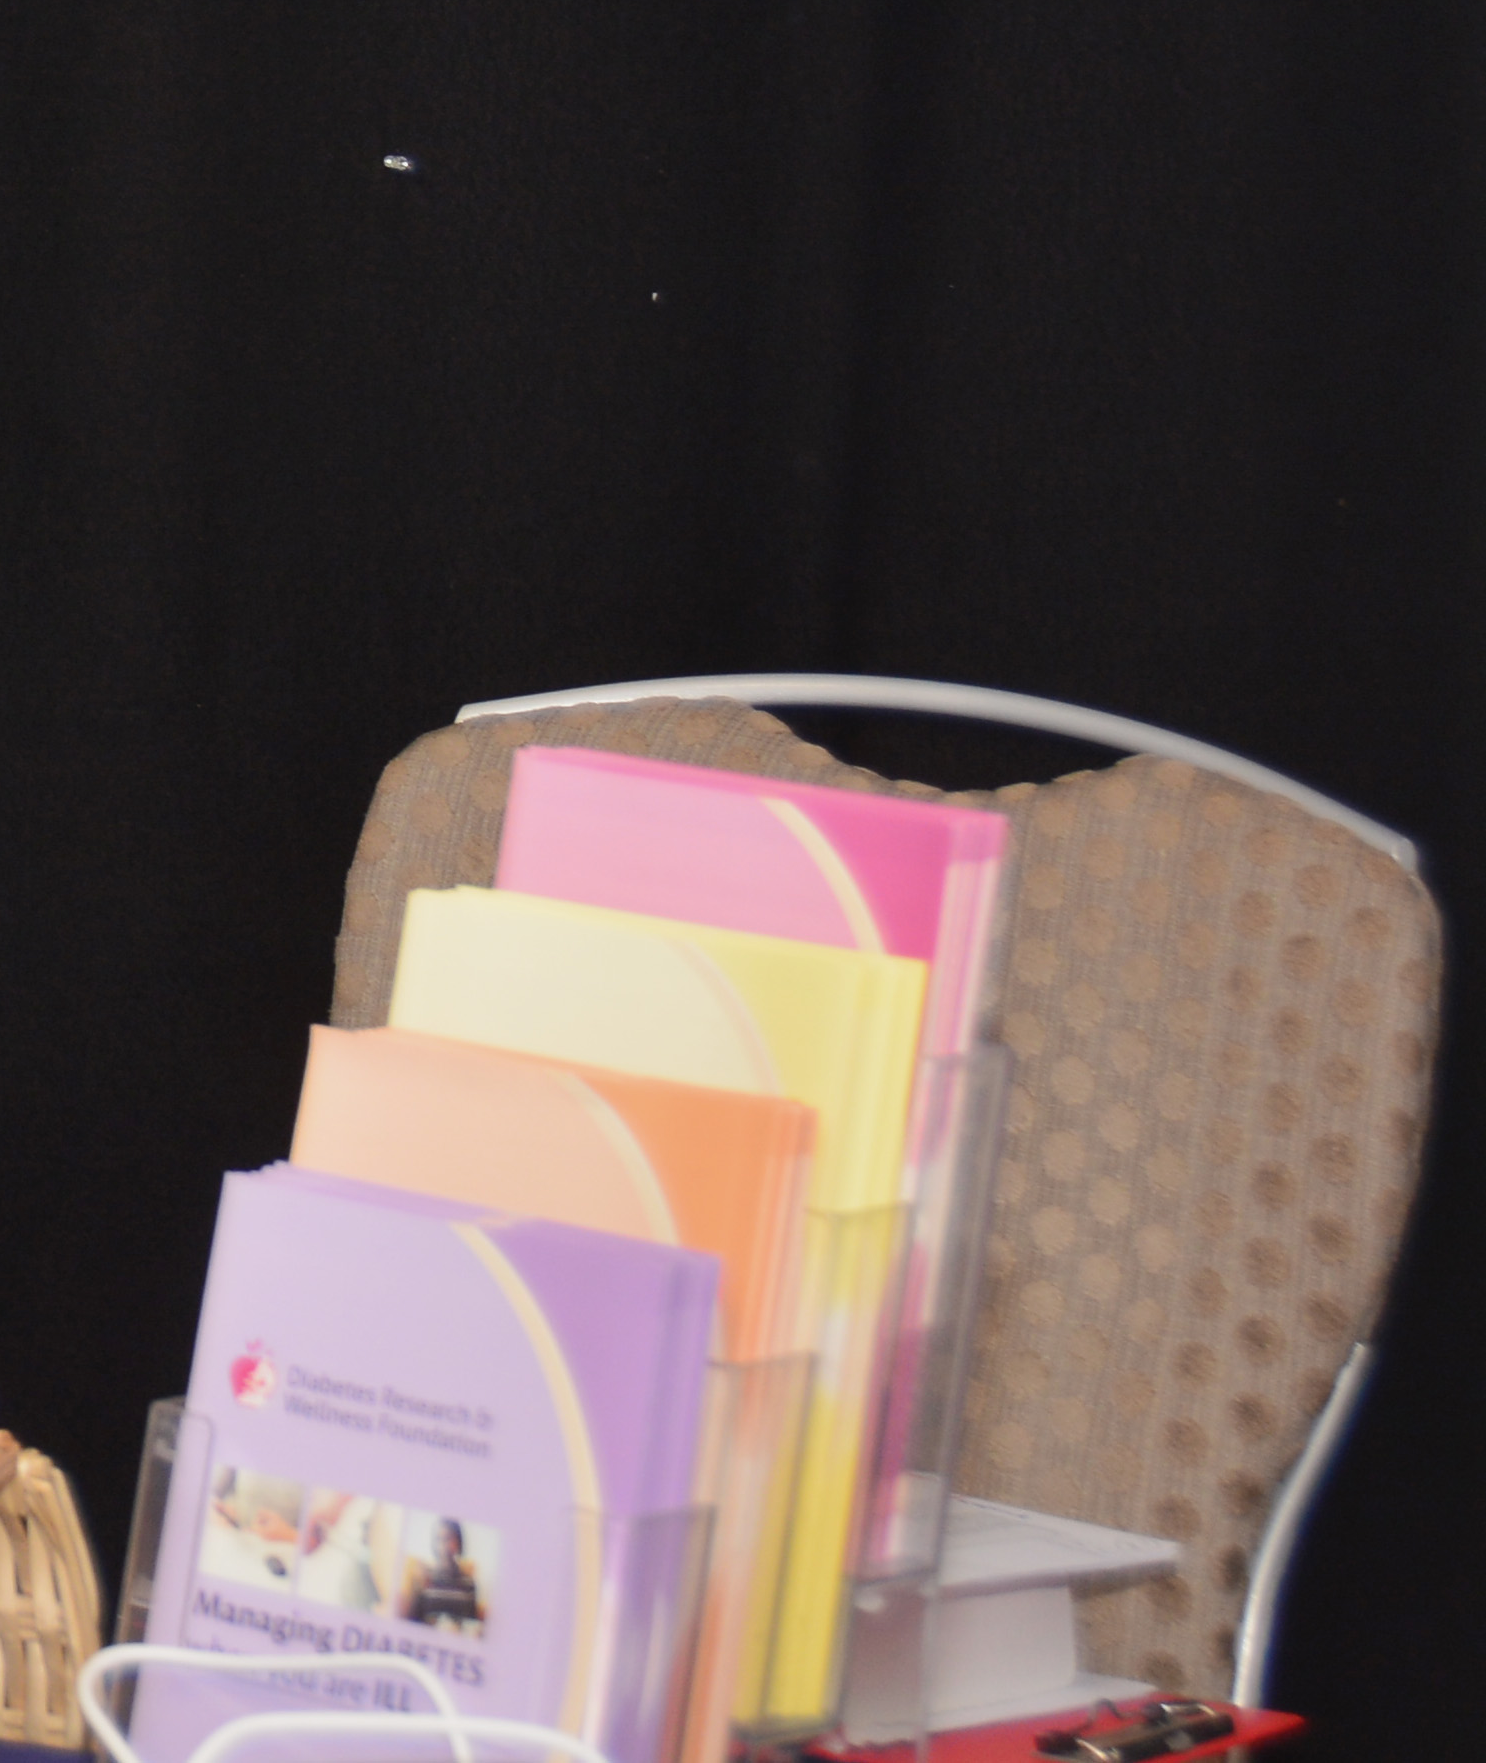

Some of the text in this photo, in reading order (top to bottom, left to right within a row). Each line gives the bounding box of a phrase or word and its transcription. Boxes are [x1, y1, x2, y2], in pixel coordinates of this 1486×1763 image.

[284, 1393, 490, 1458] Wellness Foundation
[287, 1364, 377, 1405] Diabetes
[383, 1385, 472, 1424] Research
[195, 1590, 485, 1687] Managing DIABETES
